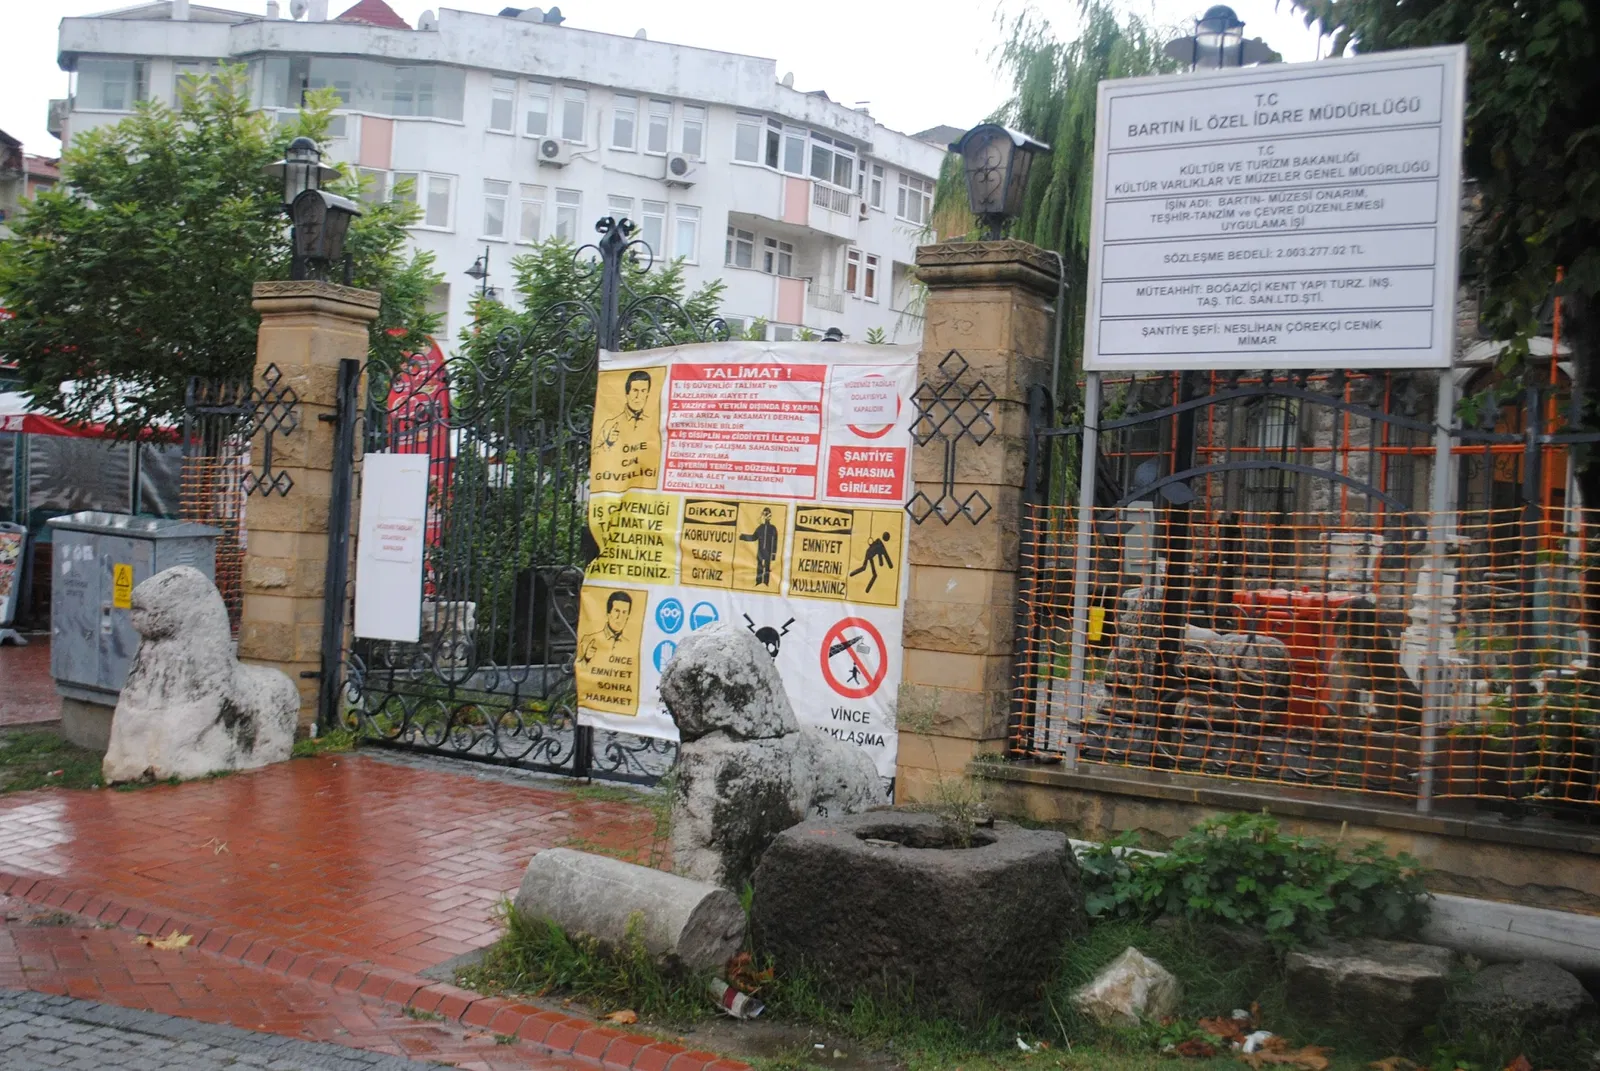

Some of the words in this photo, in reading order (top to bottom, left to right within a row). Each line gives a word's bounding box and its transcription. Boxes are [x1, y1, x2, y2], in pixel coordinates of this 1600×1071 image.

[1128, 120, 1184, 137] BARTIN
[1189, 117, 1202, 131] İL
[1207, 113, 1248, 130] ÖZEL
[1254, 109, 1303, 126] İDARE
[1309, 96, 1421, 121] MÜDÜRLÜĞÜ
[1180, 163, 1224, 175] KÜLTÜR
[1228, 161, 1242, 171] VE
[1246, 158, 1290, 170] TURİZM
[1293, 151, 1360, 167] BAKANLIĞI
[1115, 182, 1157, 194] KÜLTÜR
[1227, 175, 1241, 185] VE
[1245, 168, 1300, 183] MÜZELER
[1304, 166, 1345, 179] GENEL
[1349, 160, 1430, 176] MÜDÜRLÜĞÜ
[1165, 200, 1186, 211] İŞİN
[1190, 199, 1212, 208] ADI:
[1269, 190, 1312, 202] MÜZESİ
[1254, 204, 1297, 218] ÇEVRE
[1298, 199, 1384, 214] DÜZENLEMESİ
[1221, 219, 1287, 231] UYGULAMA
[1290, 218, 1305, 229] İŞİ
[1164, 252, 1223, 264] SÖZLEŞME
[1228, 249, 1272, 260] BEDELİ:
[1350, 245, 1364, 254] TL
[1137, 285, 1202, 296] MÜTEAHHİT:
[1206, 281, 1261, 294] BOĞAZİÇİ
[1265, 281, 1296, 291] KENT
[1300, 281, 1326, 290] YAPI
[1142, 325, 1188, 337] ŞANTİYE
[1192, 324, 1220, 335] ŞEFİ:
[1224, 322, 1282, 333] NESLİHAN
[1287, 320, 1340, 334] ÇÖREKÇİ
[1345, 319, 1382, 330] CENİK
[1238, 335, 1276, 345] MİMAR
[704, 366, 781, 378] TALİMAT
[788, 368, 792, 378] !
[844, 450, 893, 462] ŞANTİYE
[839, 467, 895, 478] ŞAHASINA
[840, 481, 892, 494] GİRİLMEZ
[593, 504, 603, 520] İŞ
[648, 520, 663, 531] VE
[685, 529, 733, 543] KORUYUCU
[609, 655, 632, 665] ÖNCE
[591, 666, 632, 678] EMNİYET
[597, 681, 632, 692] SONRA
[586, 693, 632, 706] HARAKET
[831, 705, 870, 724] VİNCE
[815, 726, 885, 747] KLAŞMA
